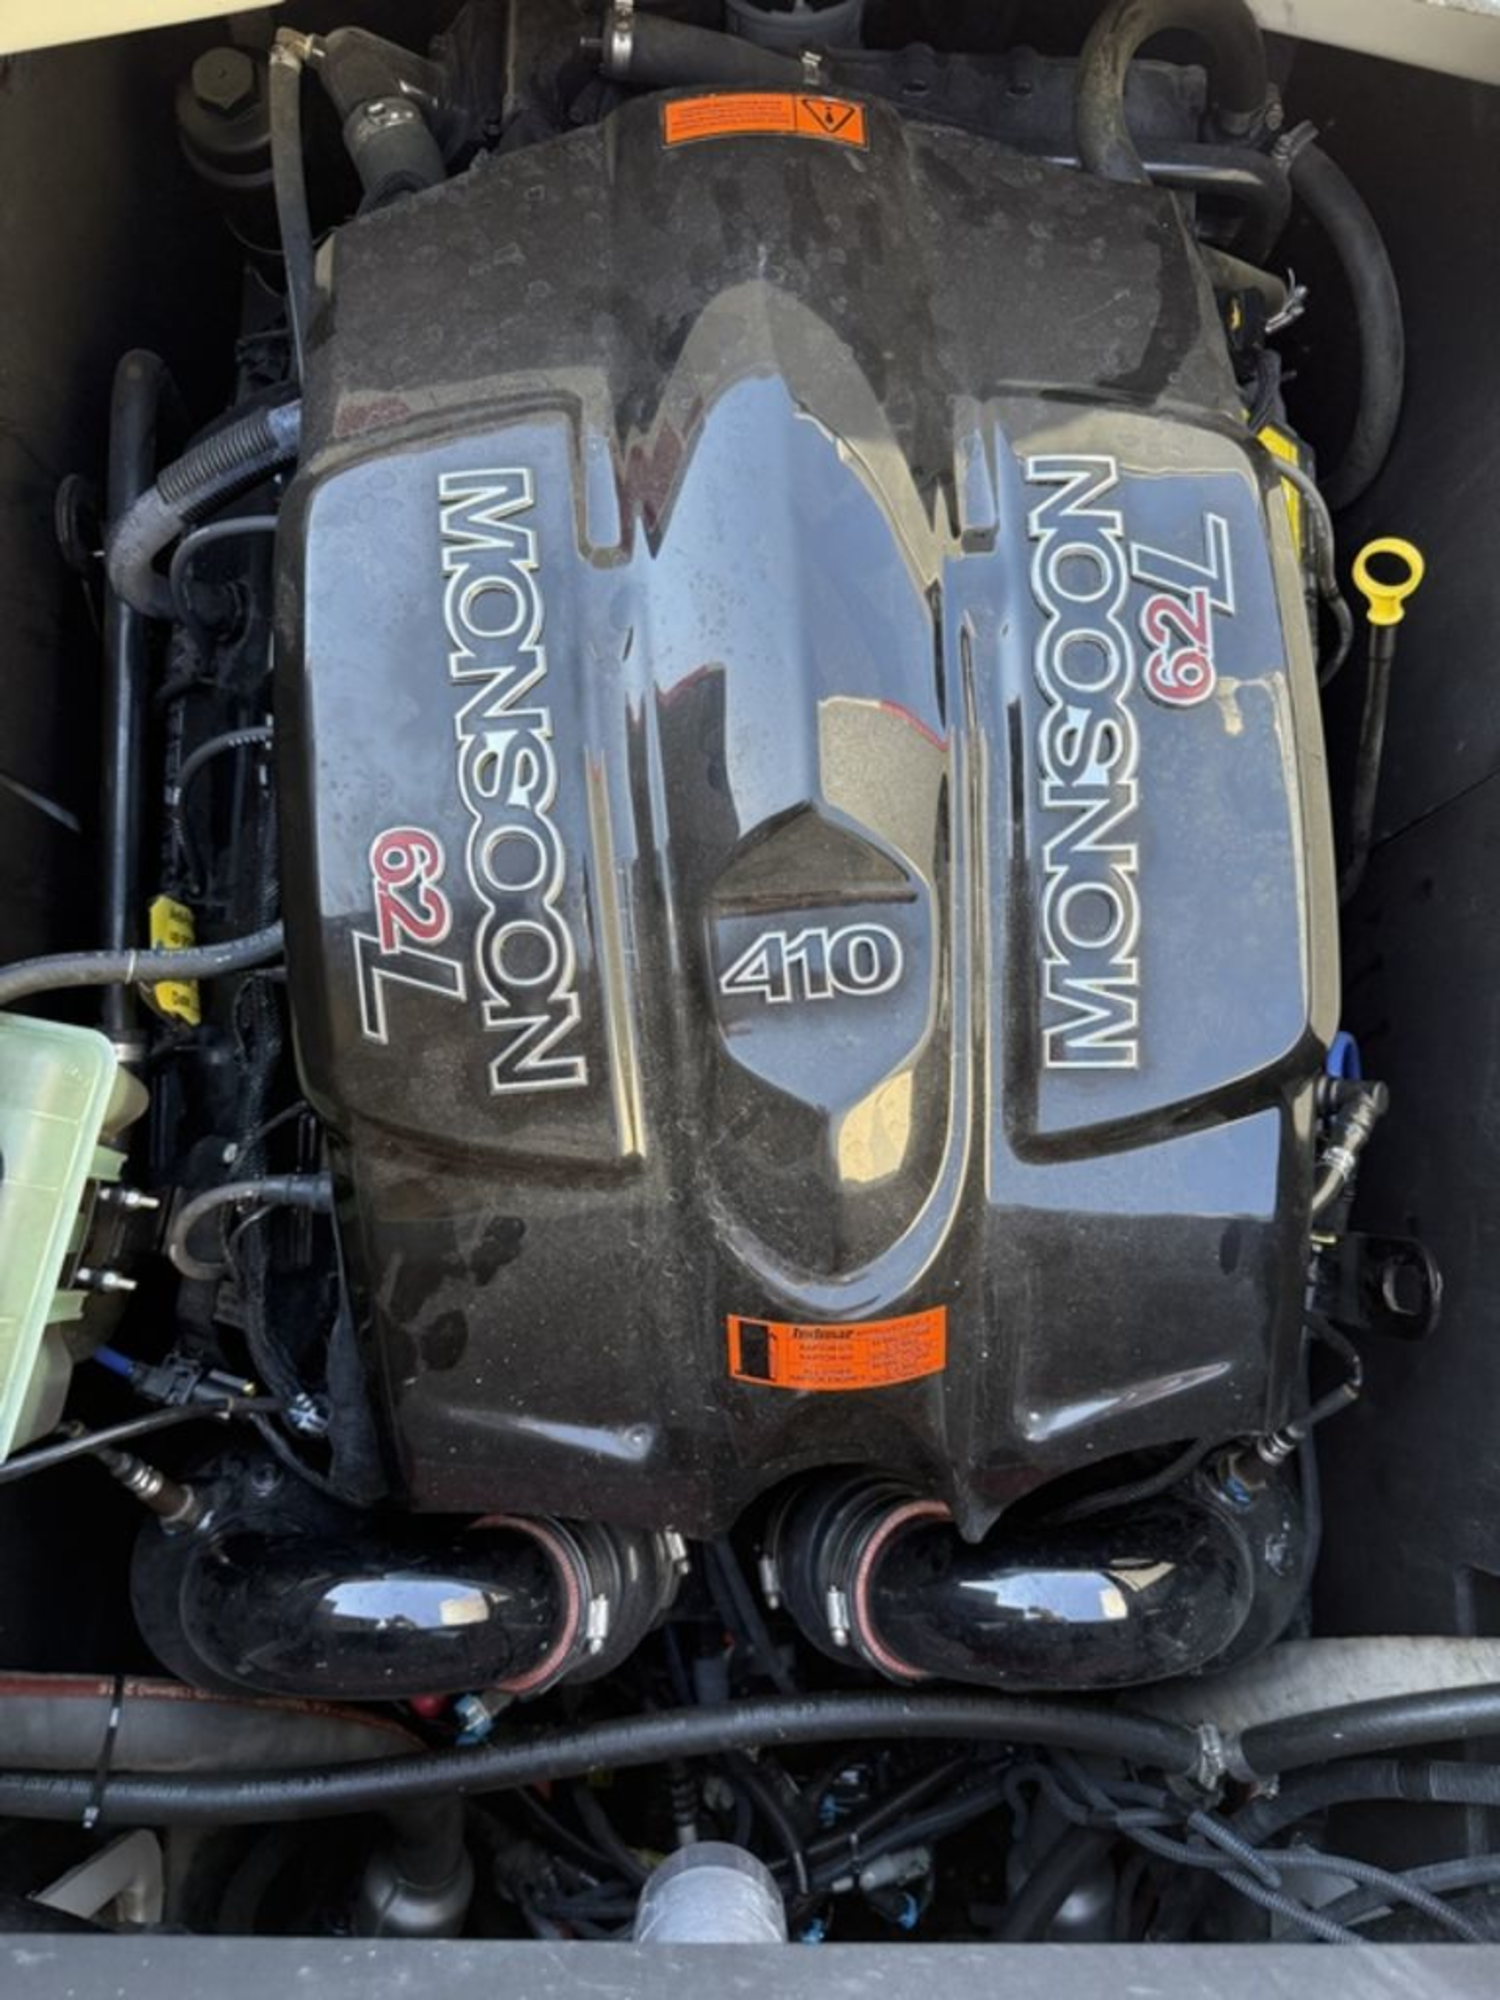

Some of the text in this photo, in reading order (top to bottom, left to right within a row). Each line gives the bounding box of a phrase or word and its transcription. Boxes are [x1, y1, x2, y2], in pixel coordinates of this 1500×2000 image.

[438, 467, 588, 1095] MONSOON
[720, 922, 905, 1003] 410
[1026, 455, 1140, 1069] MONSOON
